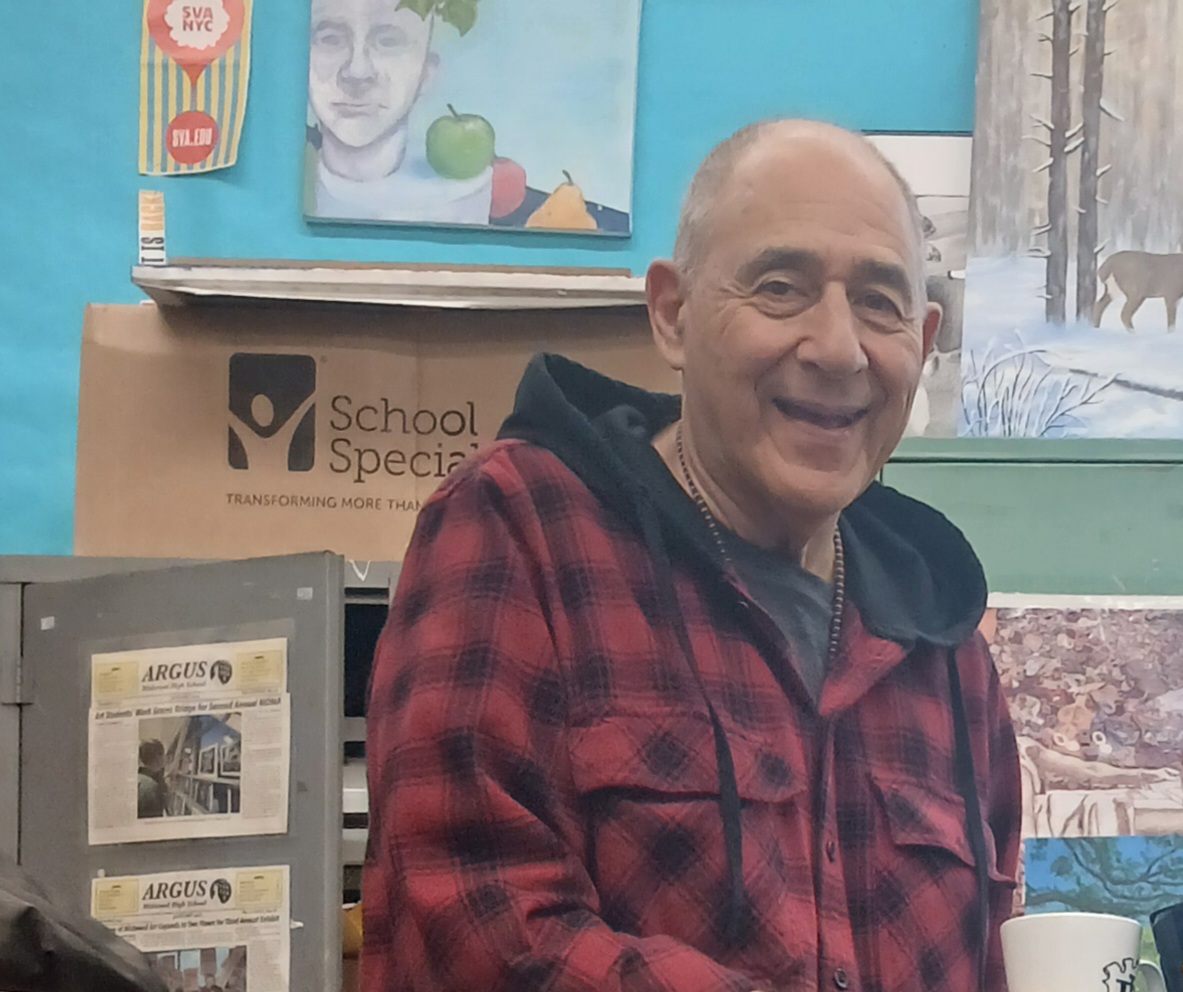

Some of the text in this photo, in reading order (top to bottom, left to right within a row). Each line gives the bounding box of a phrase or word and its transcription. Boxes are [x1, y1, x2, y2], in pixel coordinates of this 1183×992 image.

[182, 6, 213, 19] SVA
[182, 19, 213, 32] NYC
[172, 128, 212, 147] SVA.EDU
[141, 236, 165, 251] IS
[329, 395, 478, 437] School
[329, 438, 478, 484] Specia
[226, 493, 338, 509] TRANSFORMING
[340, 497, 382, 511] MORE
[141, 660, 208, 683] ARGUS
[142, 879, 208, 901] ARGUS
